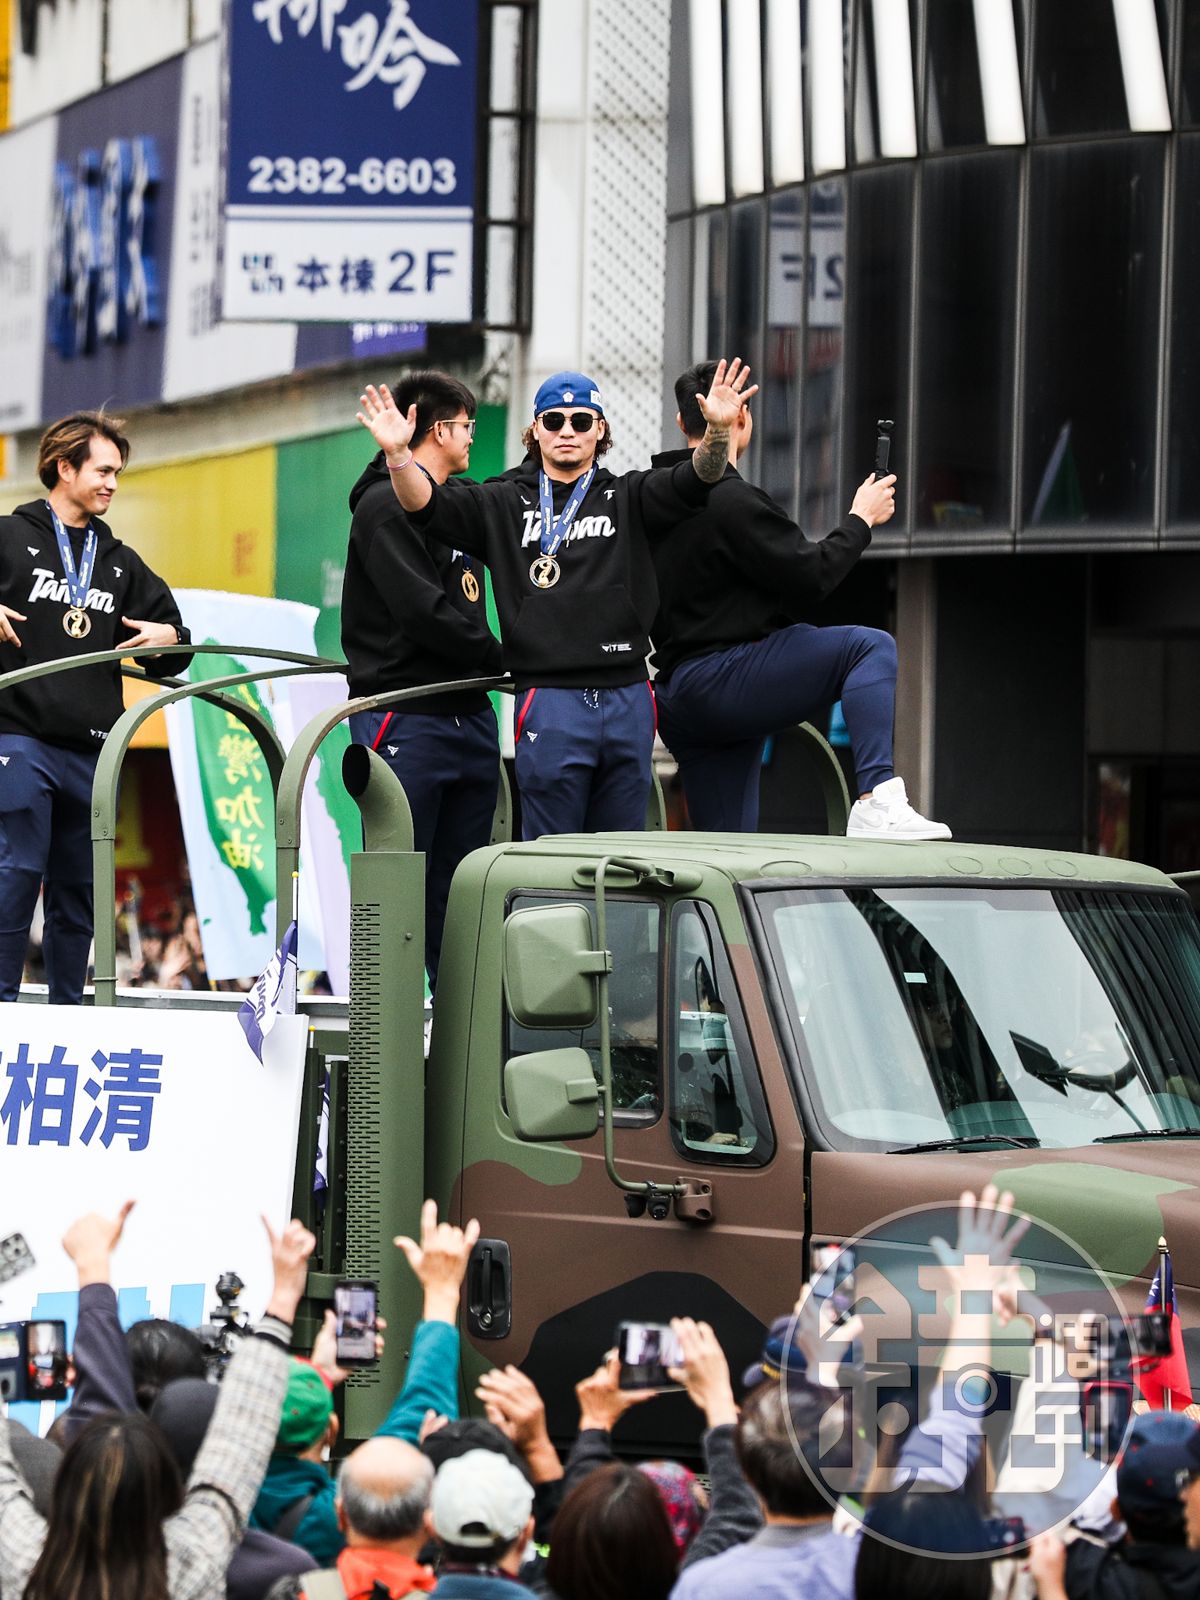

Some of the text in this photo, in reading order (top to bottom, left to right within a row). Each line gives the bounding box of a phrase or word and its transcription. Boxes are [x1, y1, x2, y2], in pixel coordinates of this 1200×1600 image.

[247, 155, 458, 195] 2382-6603
[520, 510, 616, 548] Taan
[27, 567, 116, 614] Taian
